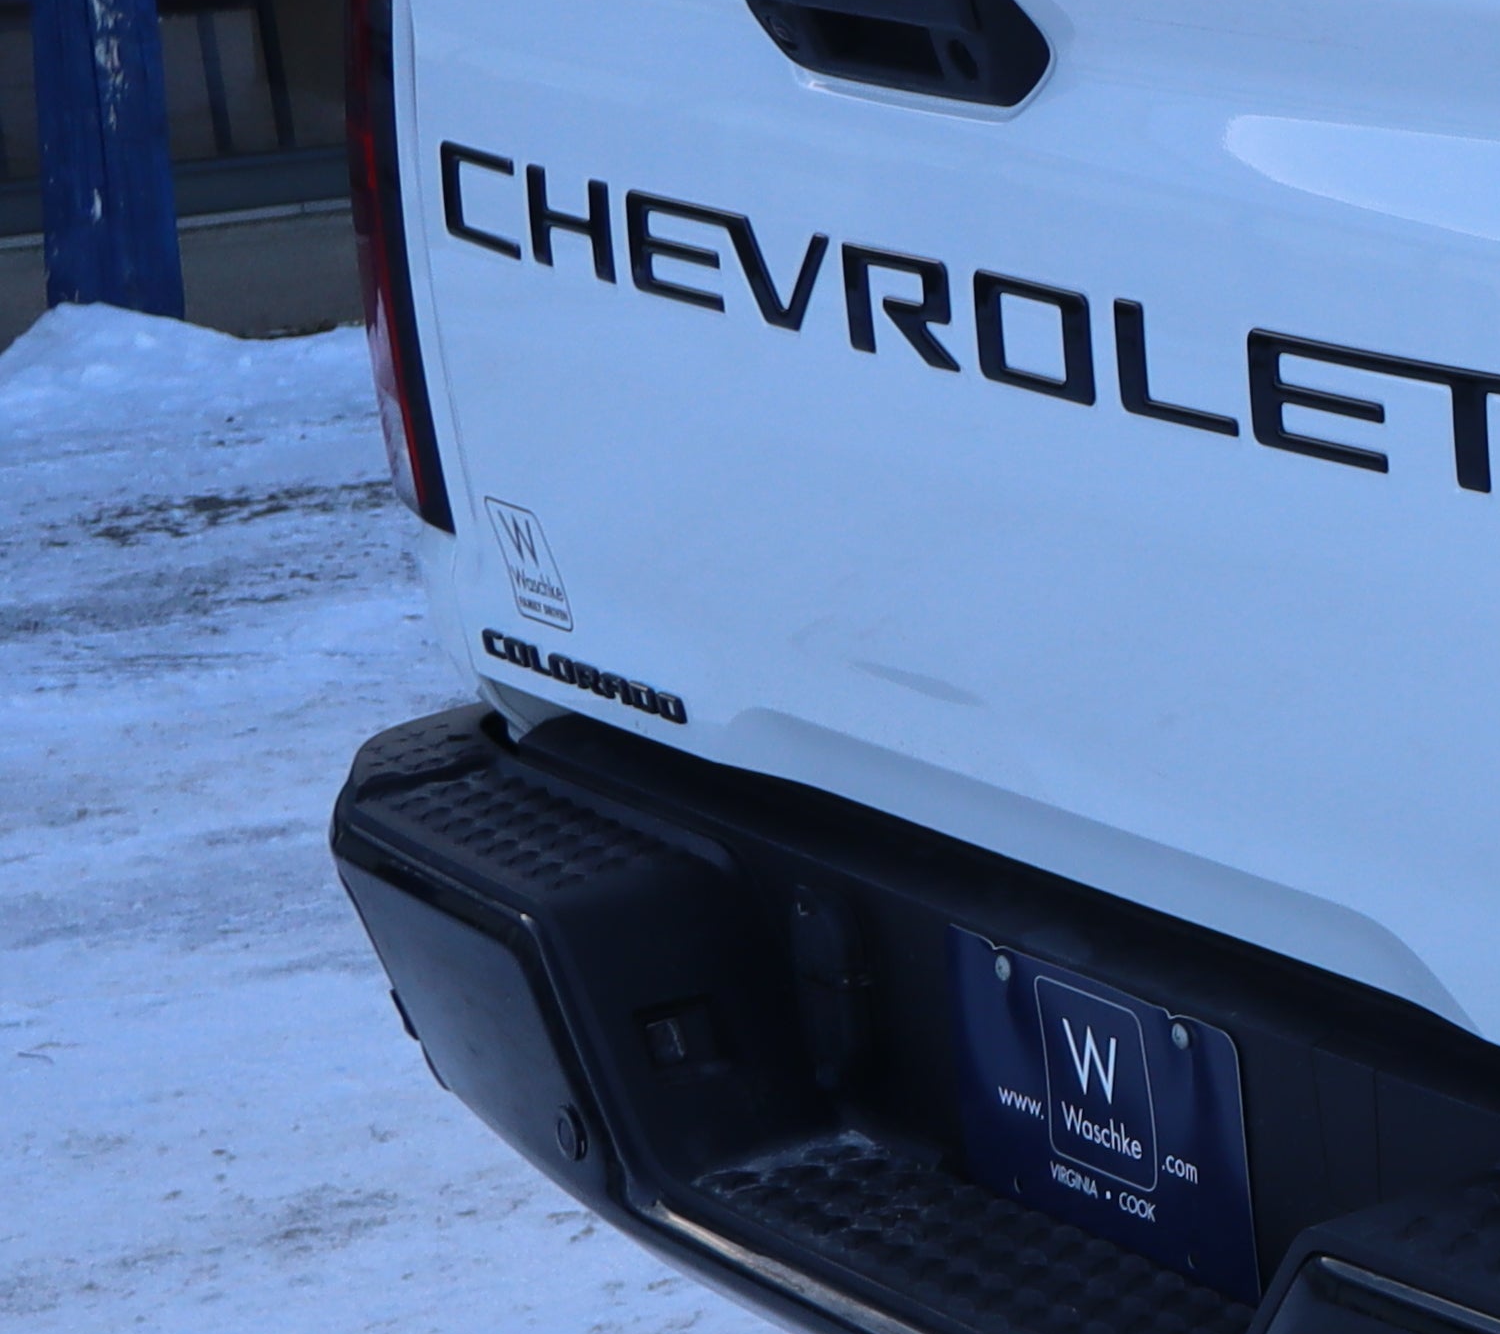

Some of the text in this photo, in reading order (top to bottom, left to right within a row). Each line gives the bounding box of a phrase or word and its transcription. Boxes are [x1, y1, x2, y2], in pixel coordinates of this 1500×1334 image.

[497, 509, 539, 568] W
[510, 565, 564, 602] Waschke
[482, 628, 688, 724] COLORADO
[1061, 1017, 1117, 1105] W
[998, 1086, 1199, 1185] www. Waschke .com
[1050, 1160, 1156, 1222] VIRGINIA COOK
